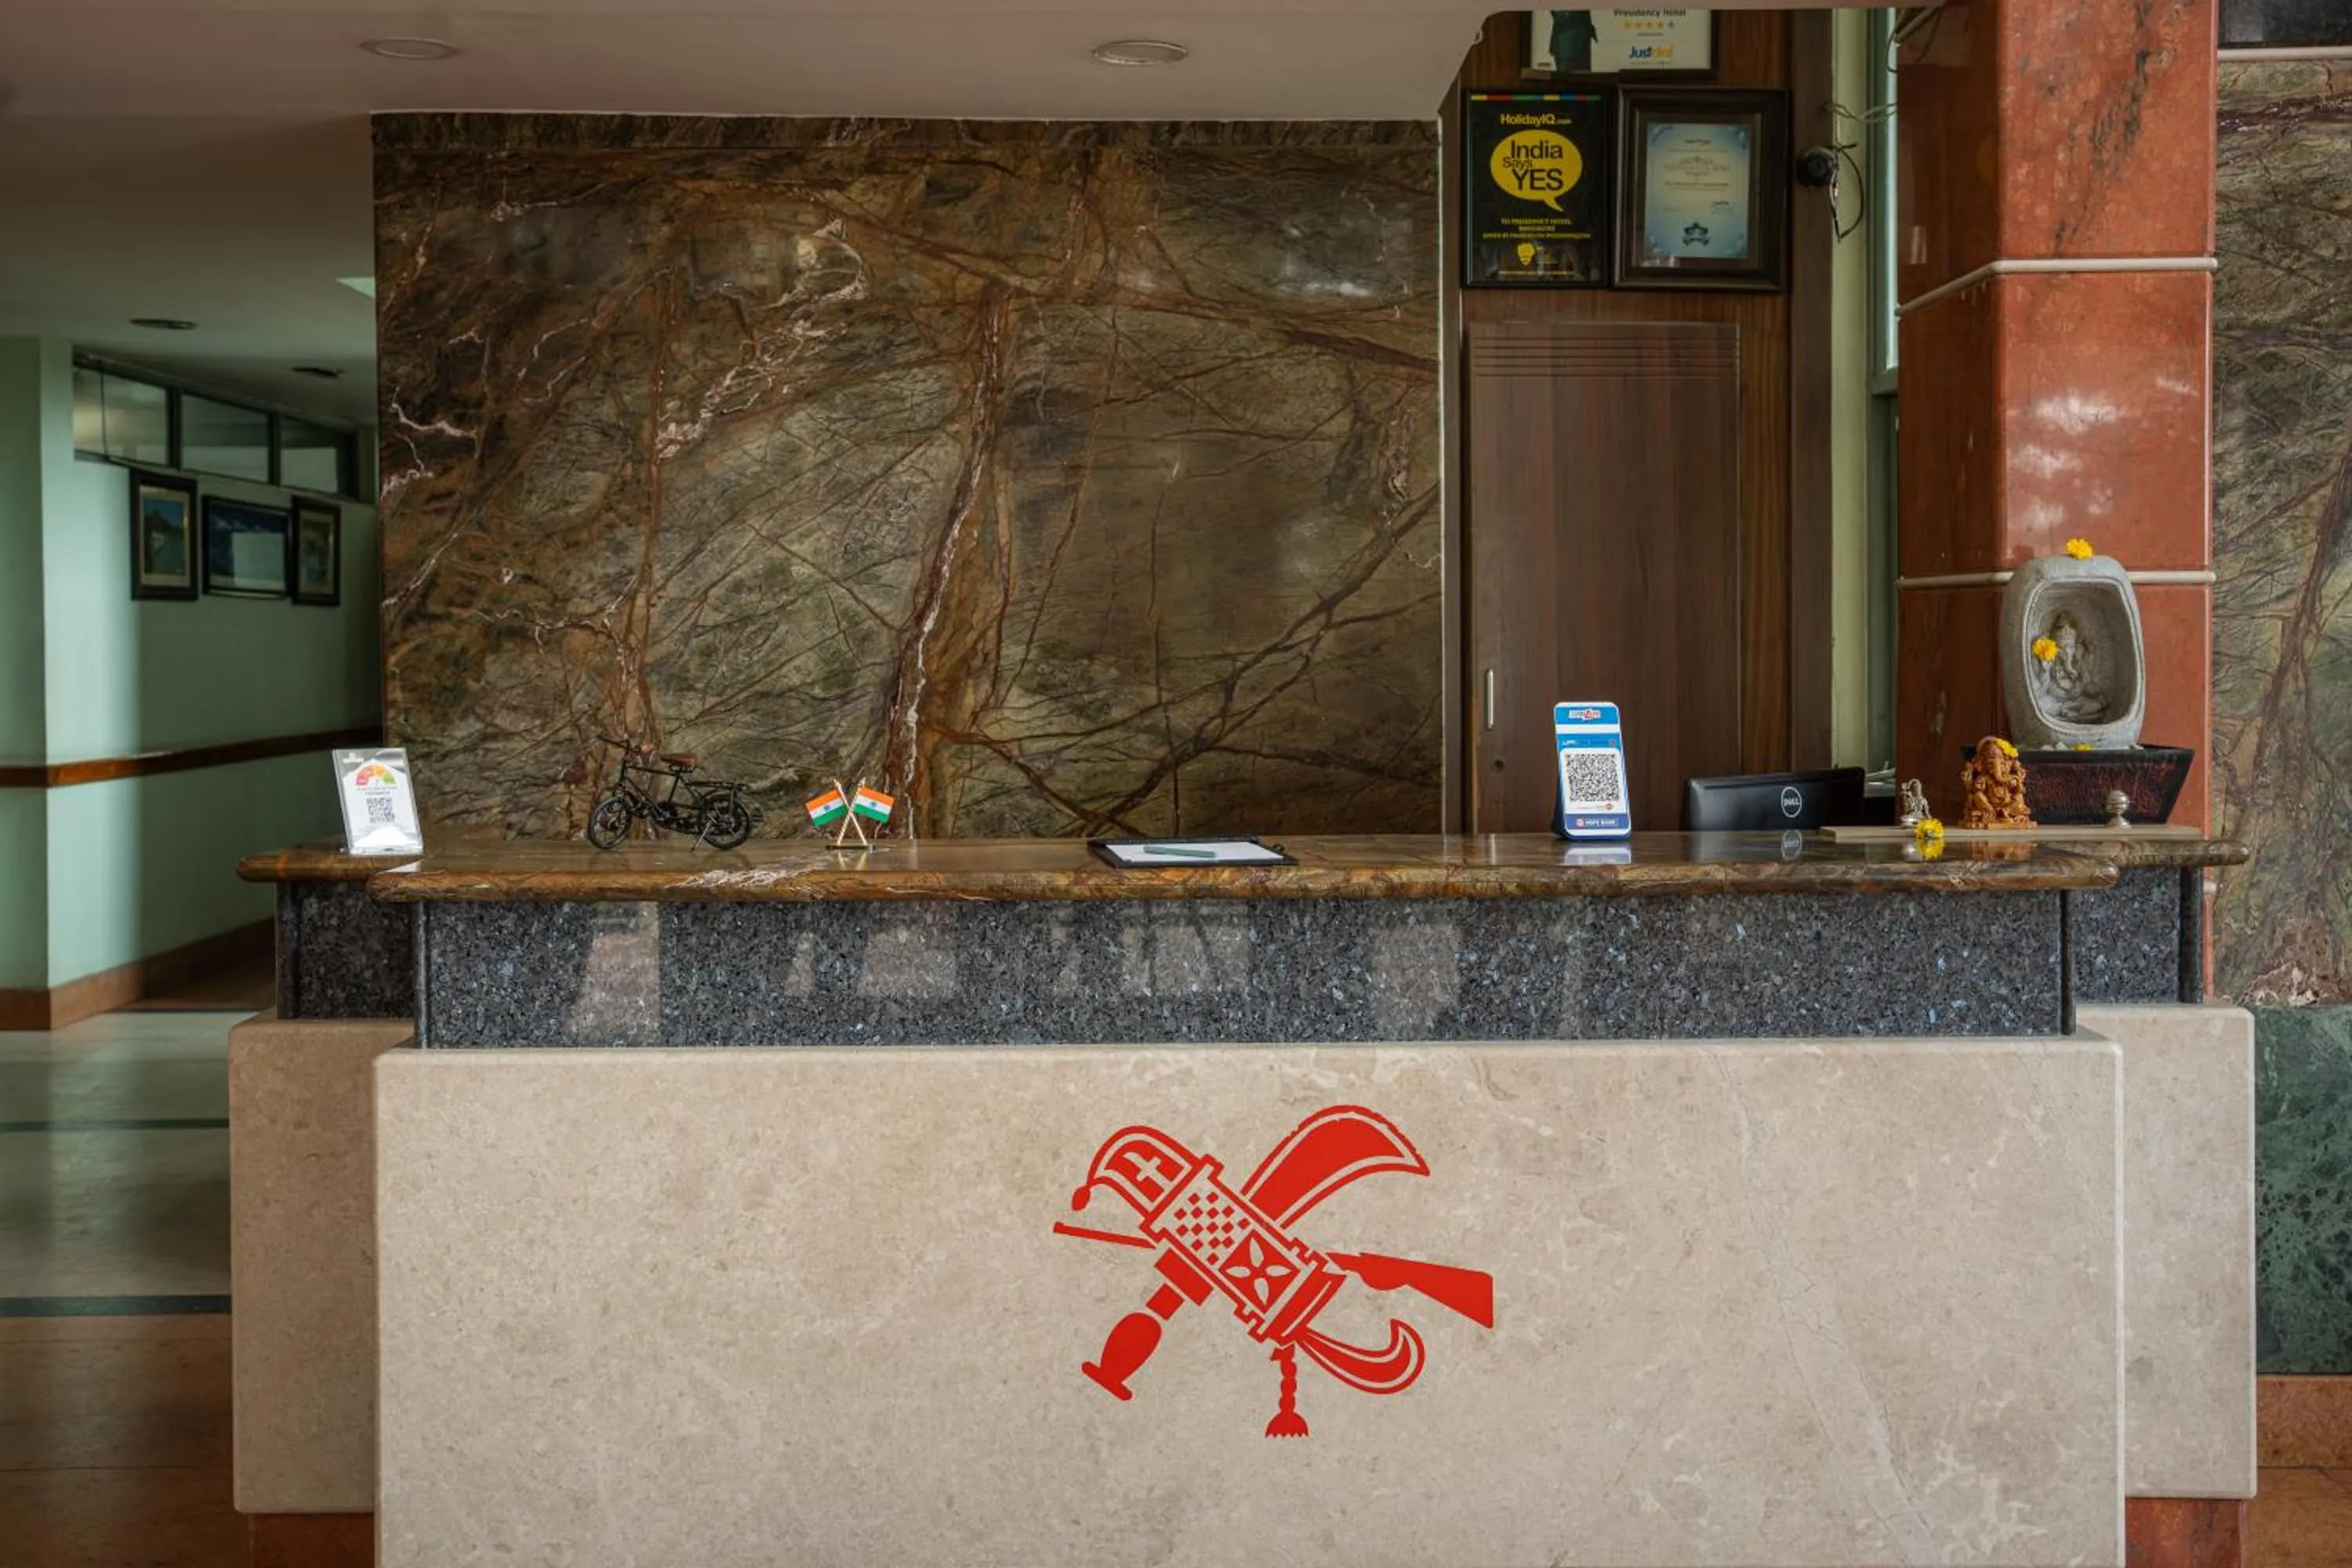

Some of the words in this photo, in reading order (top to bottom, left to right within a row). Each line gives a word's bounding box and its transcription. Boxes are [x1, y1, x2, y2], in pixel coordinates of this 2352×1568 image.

[1511, 140, 1563, 159] India
[1511, 168, 1564, 191] YES
[1784, 797, 1799, 807] DELL
